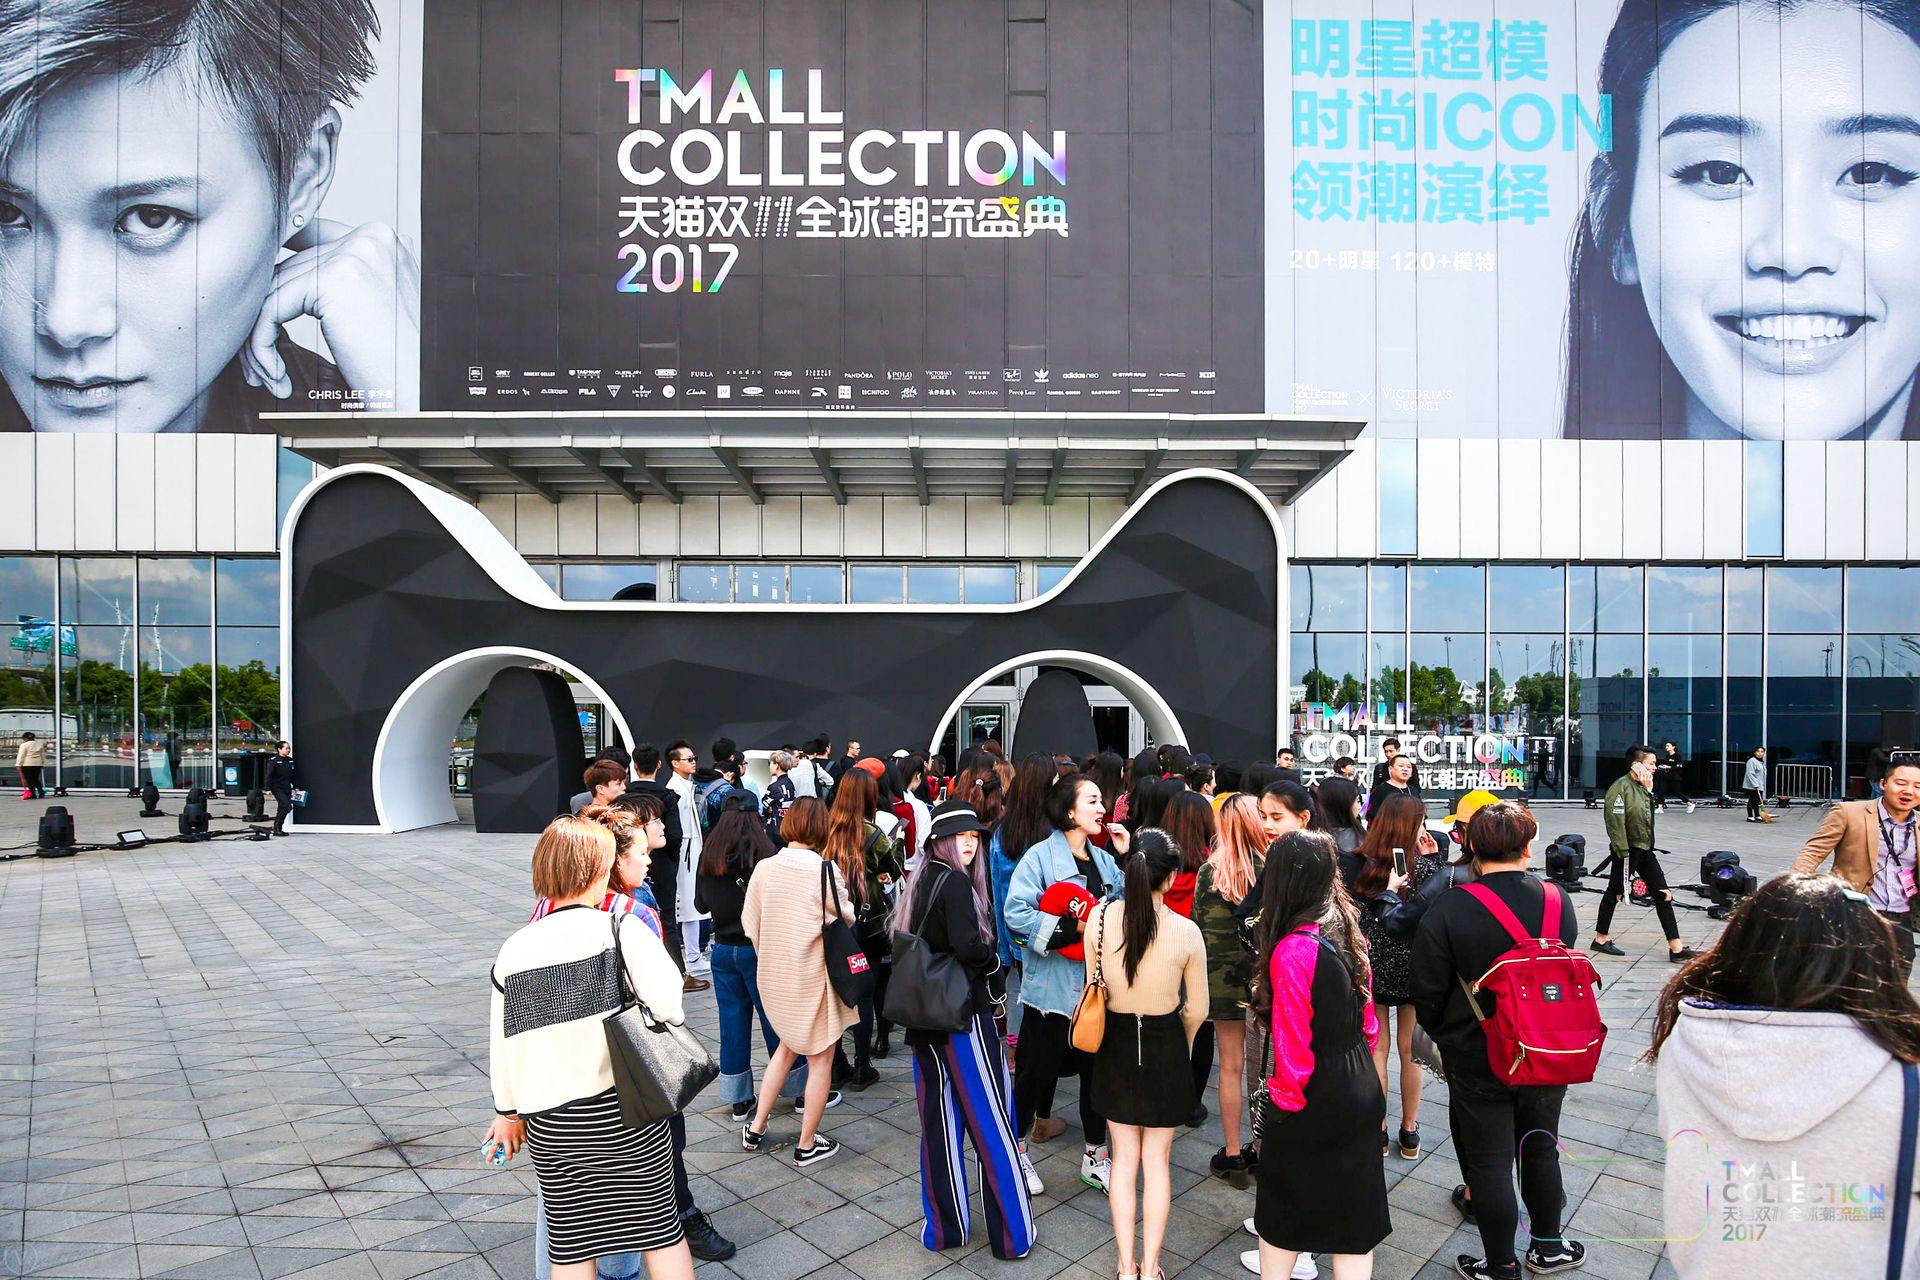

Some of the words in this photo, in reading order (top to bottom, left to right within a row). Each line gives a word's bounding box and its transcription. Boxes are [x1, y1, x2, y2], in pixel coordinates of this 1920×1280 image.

[1291, 19, 1549, 81] 明星超模
[614, 68, 843, 124] TMALL
[1291, 88, 1613, 152] 时尚ICON
[617, 128, 1067, 187] COLLECTION
[1290, 159, 1550, 225] 领潮演绎
[617, 195, 1069, 239] 天猫双11全球潮流盛典
[615, 243, 740, 293] 2017
[1288, 250, 1381, 270] 20+明星
[1390, 250, 1496, 272] 120+模特
[308, 390, 342, 400] CHRIS
[344, 390, 365, 399] LEE
[774, 369, 792, 377] maje
[1382, 388, 1453, 400] VICTORIA'S
[1394, 399, 1440, 411] SECRET
[1301, 702, 1414, 730] TMALL
